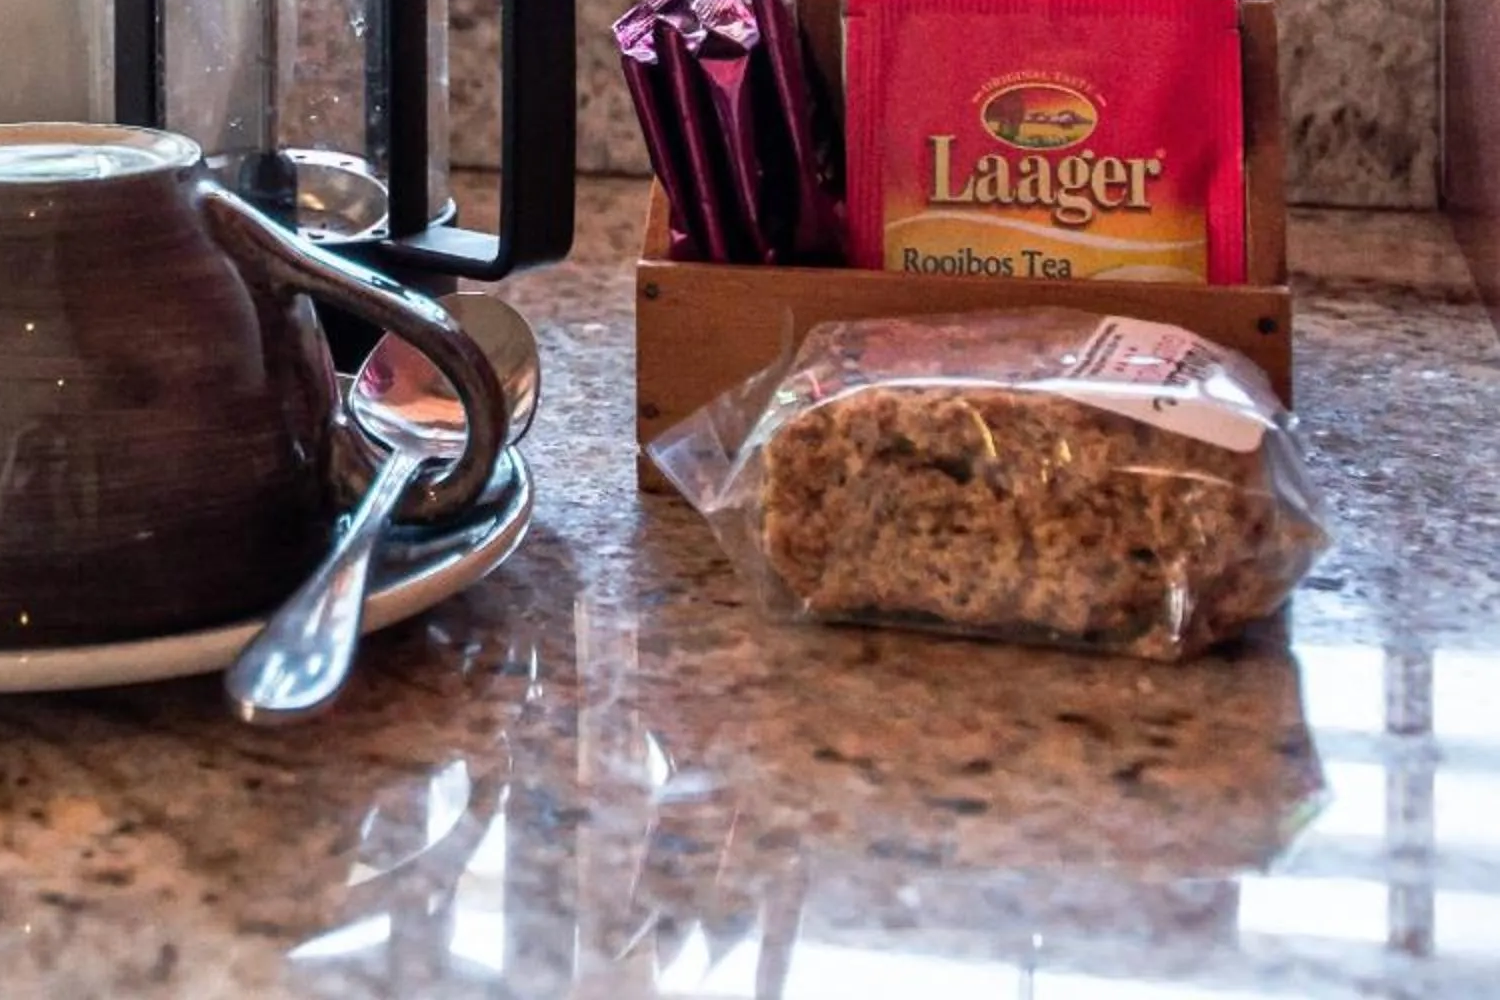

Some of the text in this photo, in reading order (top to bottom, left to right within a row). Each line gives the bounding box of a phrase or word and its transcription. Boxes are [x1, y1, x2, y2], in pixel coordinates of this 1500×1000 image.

[928, 133, 1165, 225] Laager
[902, 246, 1073, 279] Rooibos Tea
